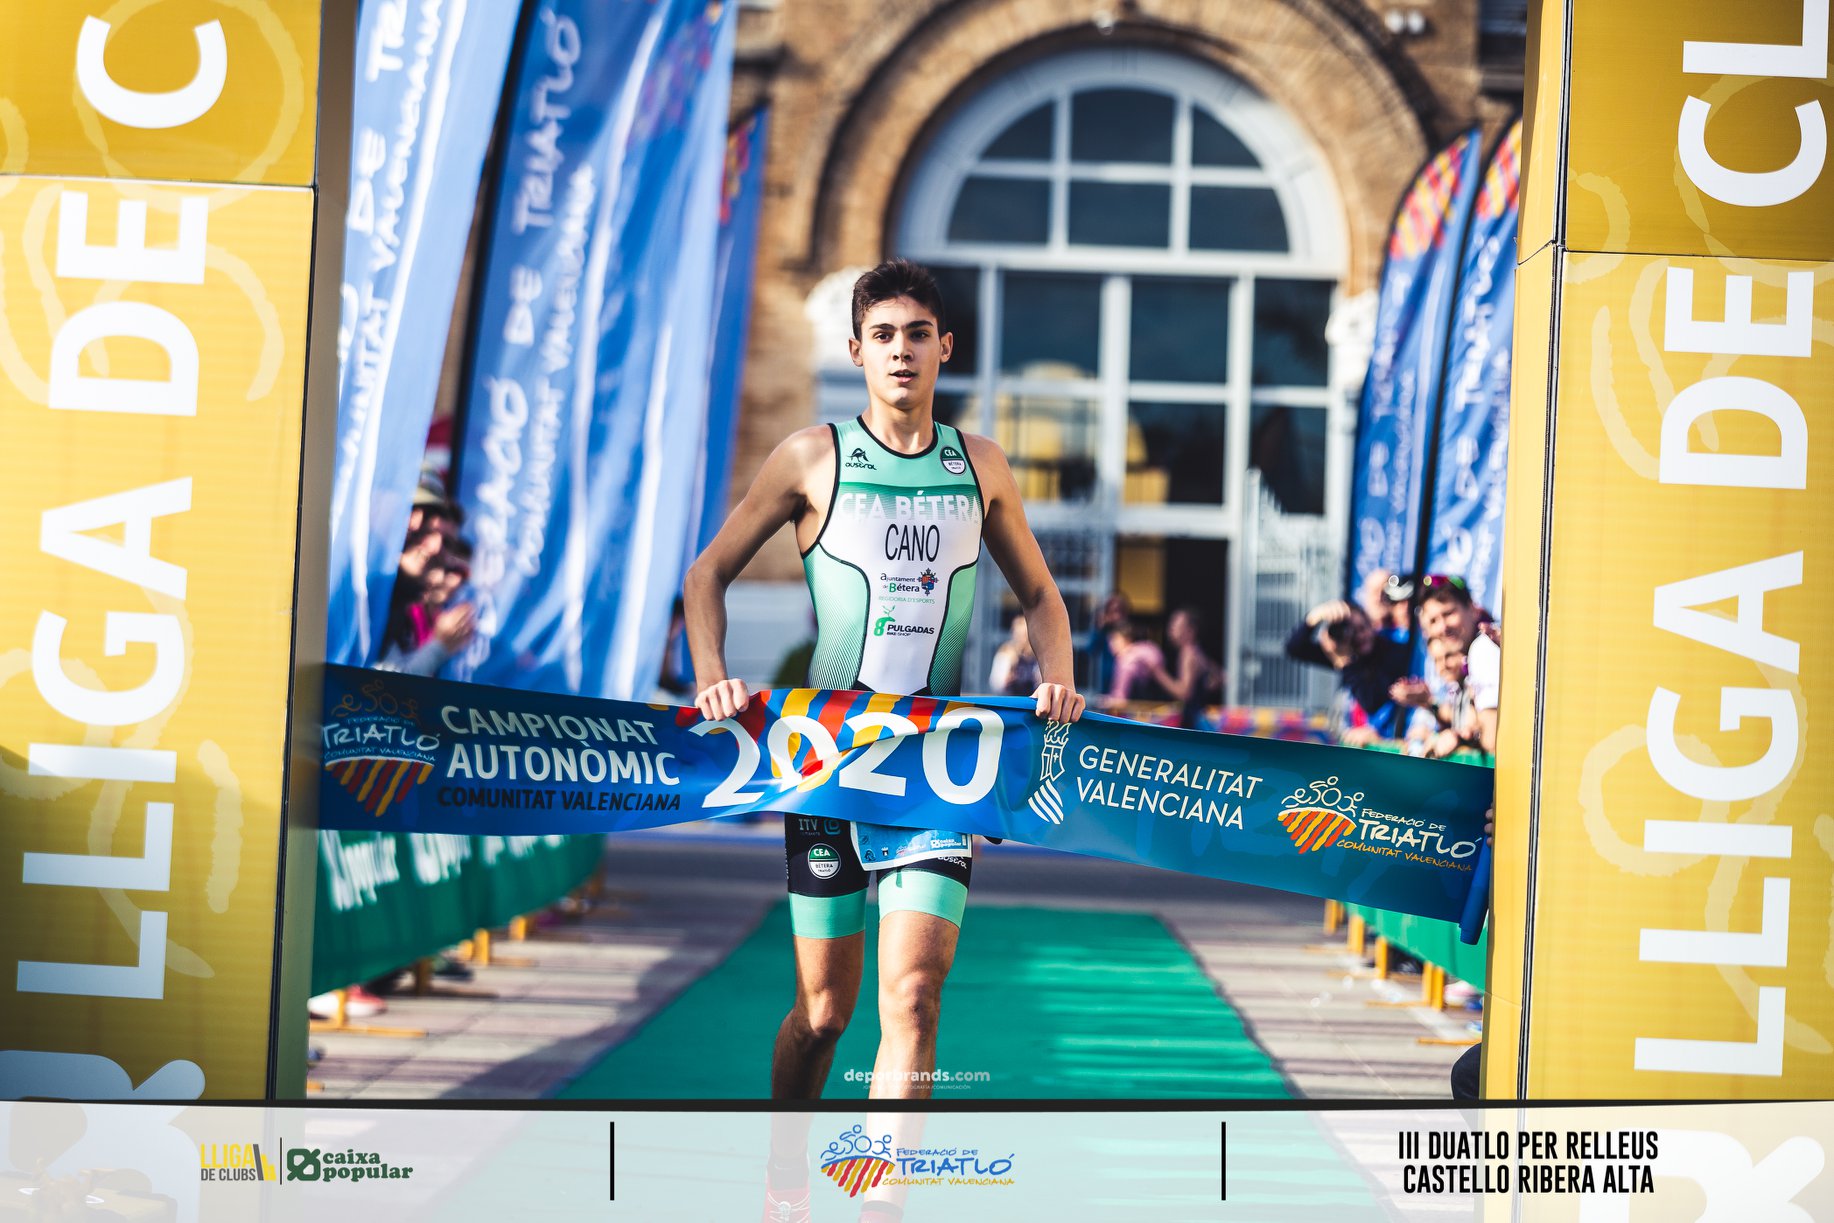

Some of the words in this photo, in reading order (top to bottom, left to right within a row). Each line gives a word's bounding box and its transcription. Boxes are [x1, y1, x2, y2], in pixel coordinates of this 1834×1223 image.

[511, 5, 582, 236] TRIATLÓ
[48, 191, 210, 417] DE
[504, 264, 543, 347] DE
[1659, 266, 1815, 490] DE
[840, 493, 886, 520] CEA
[895, 490, 981, 522] BÉTERA
[885, 523, 940, 562] CANO
[889, 583, 920, 593] Bétera
[887, 625, 935, 634] PULGADAS
[16, 476, 193, 1000] LLIGA
[323, 723, 441, 751] TRIATLÓ
[441, 705, 655, 745] CAMPIONAT
[446, 740, 680, 786] AUTONÒMIC
[688, 707, 1005, 808] 2020
[1079, 745, 1263, 799] GENERALITAT
[438, 786, 556, 810] COMUNITAT
[561, 791, 681, 812] VALENCIANA
[1076, 776, 1244, 830] VALENCIANA
[1634, 550, 1803, 1076] LLIGA
[799, 818, 818, 830] ITV
[1358, 818, 1482, 859] TRIATLÓ
[1361, 808, 1426, 827] FEDERACIÓ
[1428, 823, 1447, 832] DE
[1336, 839, 1402, 859] COMUNITAT
[1404, 852, 1472, 872] VALENCIANA
